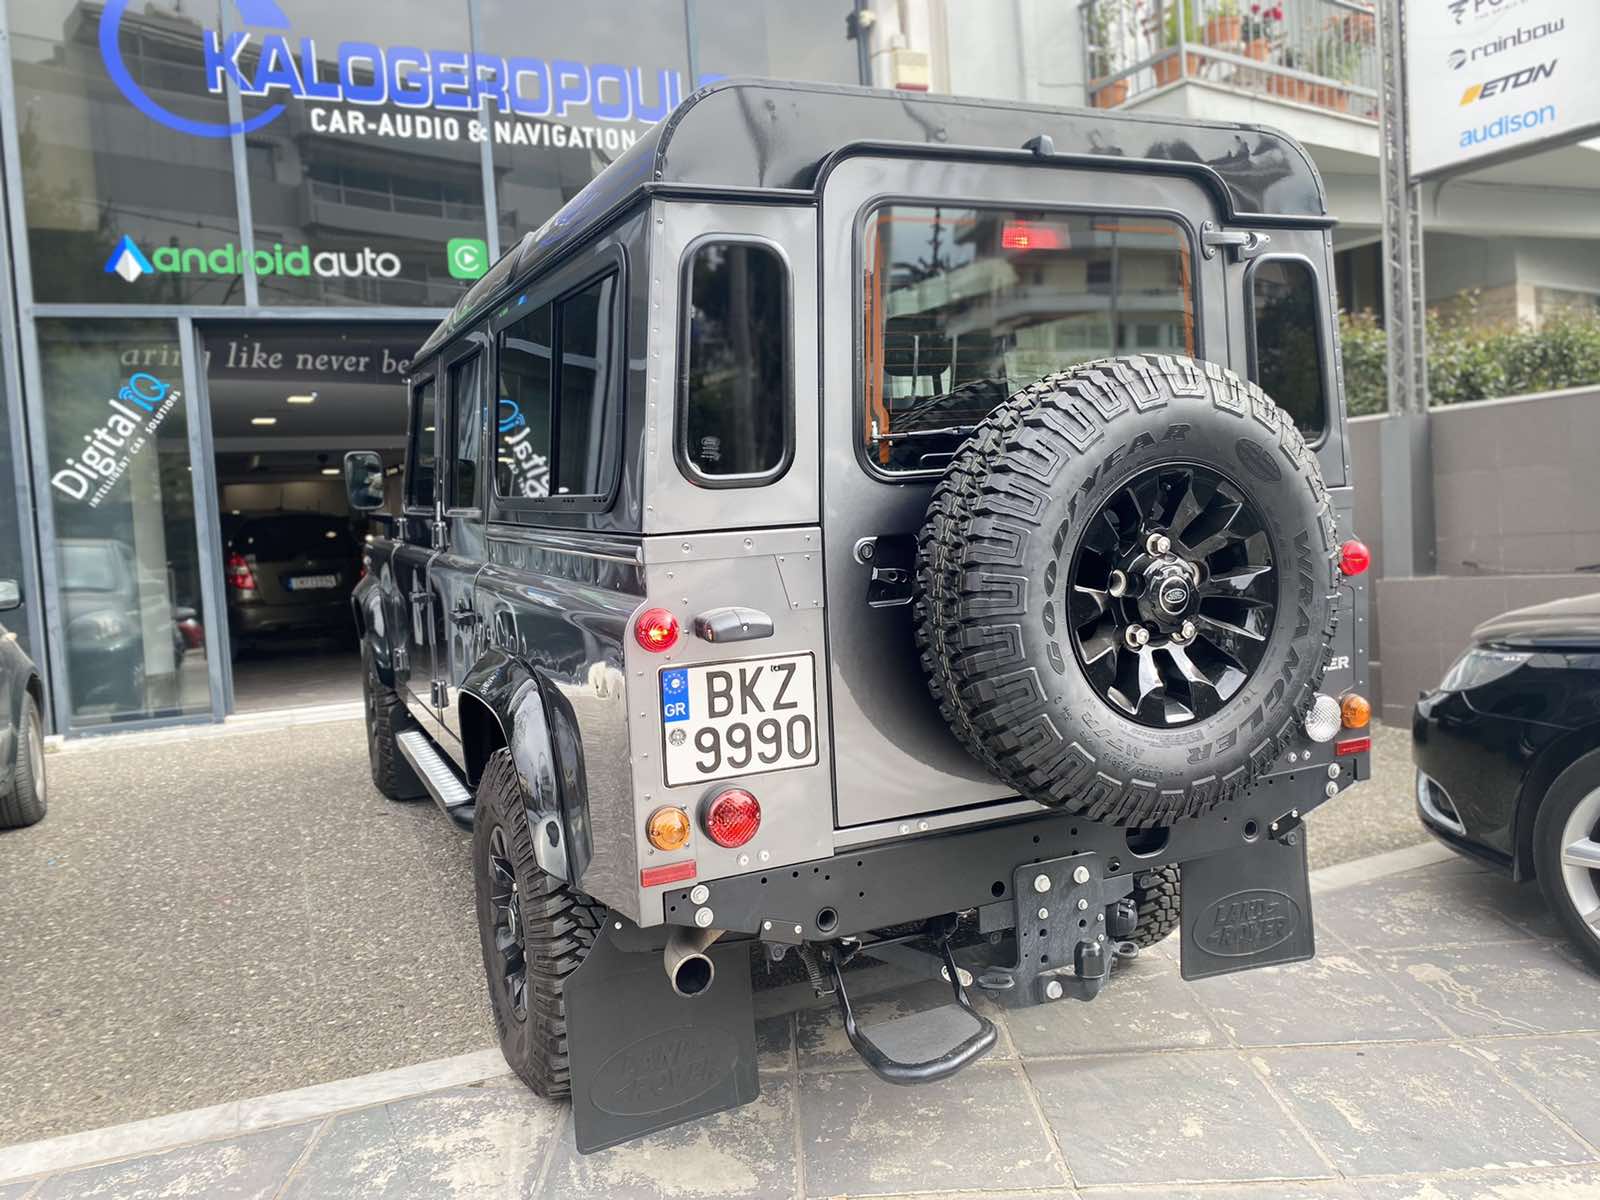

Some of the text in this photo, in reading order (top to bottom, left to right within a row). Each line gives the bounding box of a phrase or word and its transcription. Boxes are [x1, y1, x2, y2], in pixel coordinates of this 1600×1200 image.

[1471, 18, 1565, 61] rainbow
[202, 27, 729, 125] KALOGEROPOU
[1479, 57, 1559, 99] ETON
[311, 107, 637, 151] CAR-AUDIO & NAVIGATION
[1459, 104, 1556, 148] audison
[152, 243, 400, 278] android auto
[121, 342, 413, 384] ari like never be
[51, 399, 142, 500] Digital
[88, 390, 181, 508] INTELLIGENT CAR SOLUTIONS
[1042, 423, 1191, 676] GOODYEAR
[1186, 528, 1314, 765] WRANGLER
[1322, 655, 1350, 672] ER
[664, 702, 686, 717] GR
[705, 662, 798, 719] BKZ
[694, 714, 812, 774] 9990
